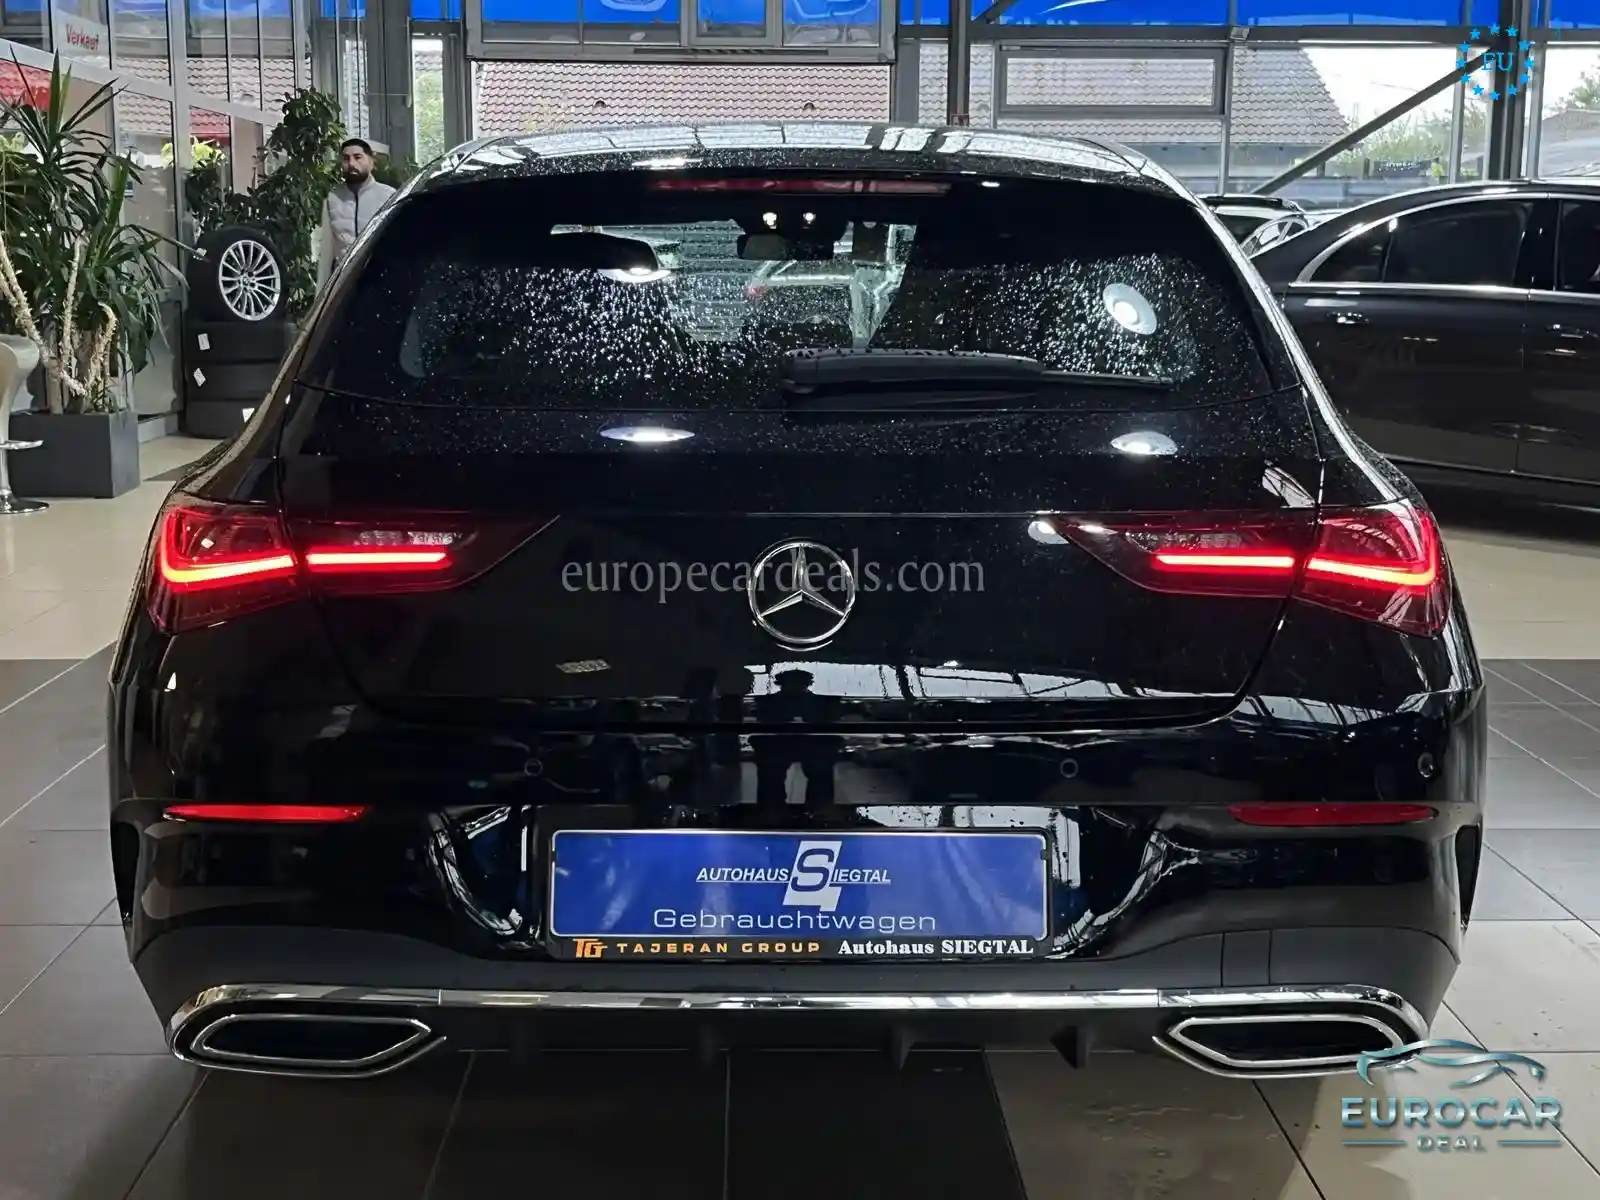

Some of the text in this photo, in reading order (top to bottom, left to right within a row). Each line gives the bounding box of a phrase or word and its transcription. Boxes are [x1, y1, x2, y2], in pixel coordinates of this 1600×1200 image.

[65, 24, 100, 50] Verkauf
[696, 867, 790, 882] AUTOHAUS
[653, 908, 937, 934] Gebrauchtwagen
[616, 942, 729, 954] TAJERAN
[741, 942, 821, 954] GROUP
[837, 939, 1034, 956] Autohaus SIEGTAL
